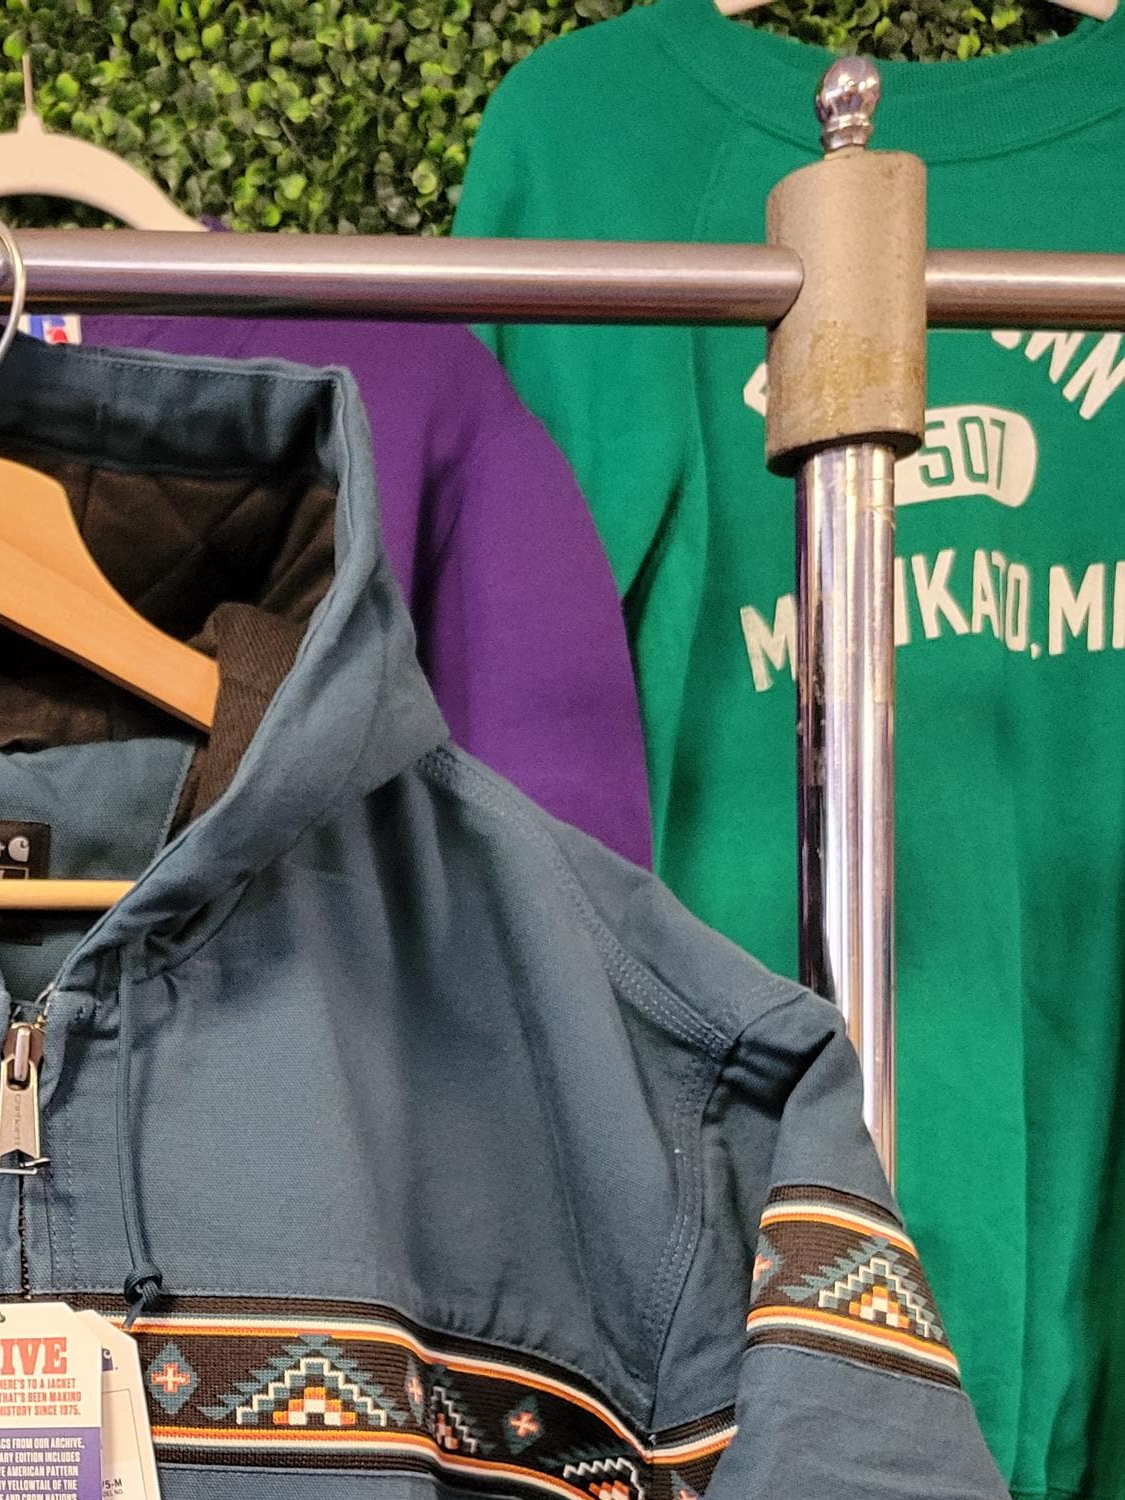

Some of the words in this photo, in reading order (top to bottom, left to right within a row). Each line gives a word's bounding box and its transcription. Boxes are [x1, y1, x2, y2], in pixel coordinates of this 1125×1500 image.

[27, 1379, 37, 1389] TO
[39, 1379, 45, 1389] A
[47, 1378, 76, 1389] JACKET
[28, 1392, 47, 1402] BEEN
[49, 1391, 82, 1402] MAKING
[34, 1405, 57, 1416] SINCE
[60, 1404, 82, 1416] 1975.
[12, 1438, 33, 1449] FROM
[34, 1437, 49, 1449] OUR
[51, 1437, 85, 1449] ARCHIVE,
[15, 1452, 43, 1462] EDITION
[45, 1452, 80, 1462] INCLUDES
[7, 1466, 44, 1476] AMERICAN
[46, 1466, 78, 1476] PATTERN
[8, 1480, 51, 1490] YELLOWTAIL
[53, 1480, 62, 1490] OF
[63, 1480, 77, 1490] THE
